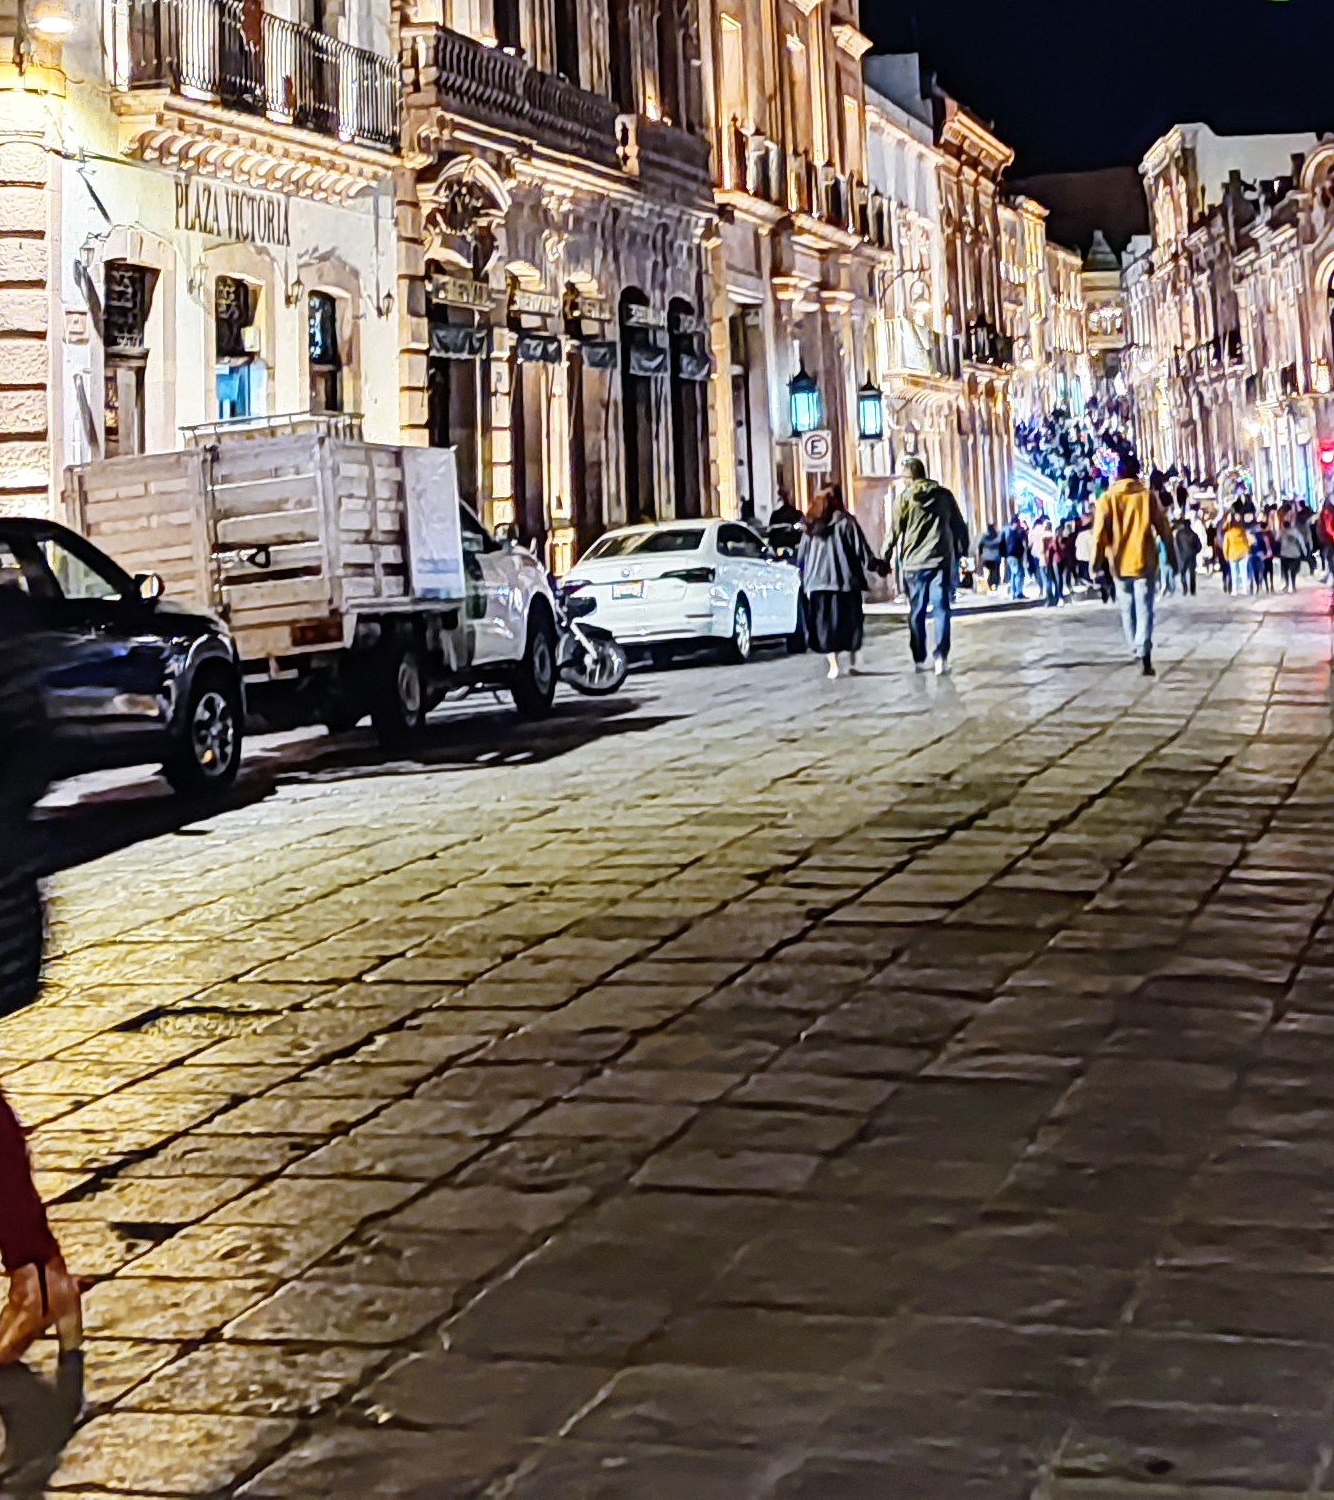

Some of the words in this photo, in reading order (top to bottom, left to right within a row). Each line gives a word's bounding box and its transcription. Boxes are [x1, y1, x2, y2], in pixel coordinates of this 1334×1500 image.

[174, 181, 221, 237] PLAZA
[225, 187, 291, 247] VICTORIA
[810, 439, 823, 456] E
